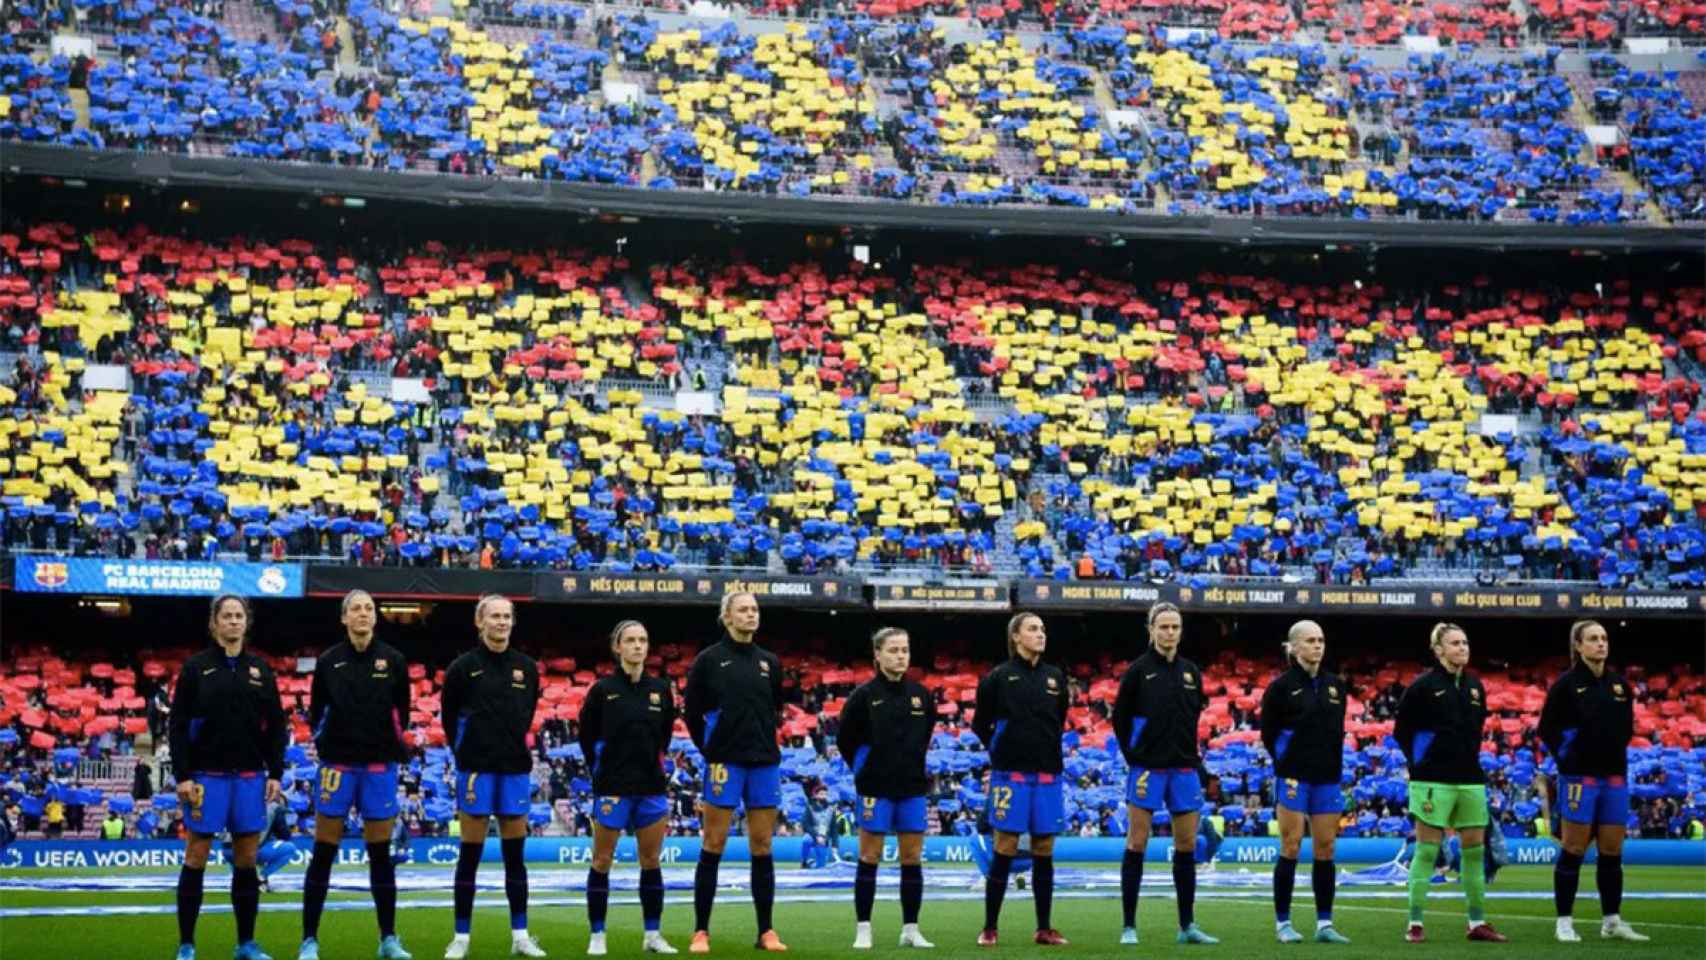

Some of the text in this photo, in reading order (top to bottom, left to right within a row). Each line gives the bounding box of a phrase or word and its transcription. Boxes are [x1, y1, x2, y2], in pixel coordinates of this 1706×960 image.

[103, 565, 224, 580] FC BARCELONA
[106, 576, 221, 591] REAL MADRID
[613, 579, 636, 595] QUE
[638, 579, 655, 593] UN
[656, 580, 684, 593] CLUB
[747, 581, 769, 595] QUE
[771, 582, 812, 595] ORGULL
[1061, 586, 1159, 601] MORE THAN PROUD
[1225, 589, 1247, 605] QUE
[1247, 590, 1285, 604] TALENT
[1321, 591, 1416, 605] MORE THAN TALENT
[1476, 594, 1498, 608] QUE
[1499, 595, 1516, 607] UN
[1516, 595, 1542, 608] CLUB
[1602, 595, 1625, 610] QUE
[1635, 596, 1689, 609] JUGADORS
[319, 767, 341, 792] 10
[710, 763, 728, 784] 16
[993, 786, 1012, 810] 12
[35, 850, 88, 867] UEFA
[1237, 846, 1278, 863] МИР
[1517, 847, 1557, 864] МИР
